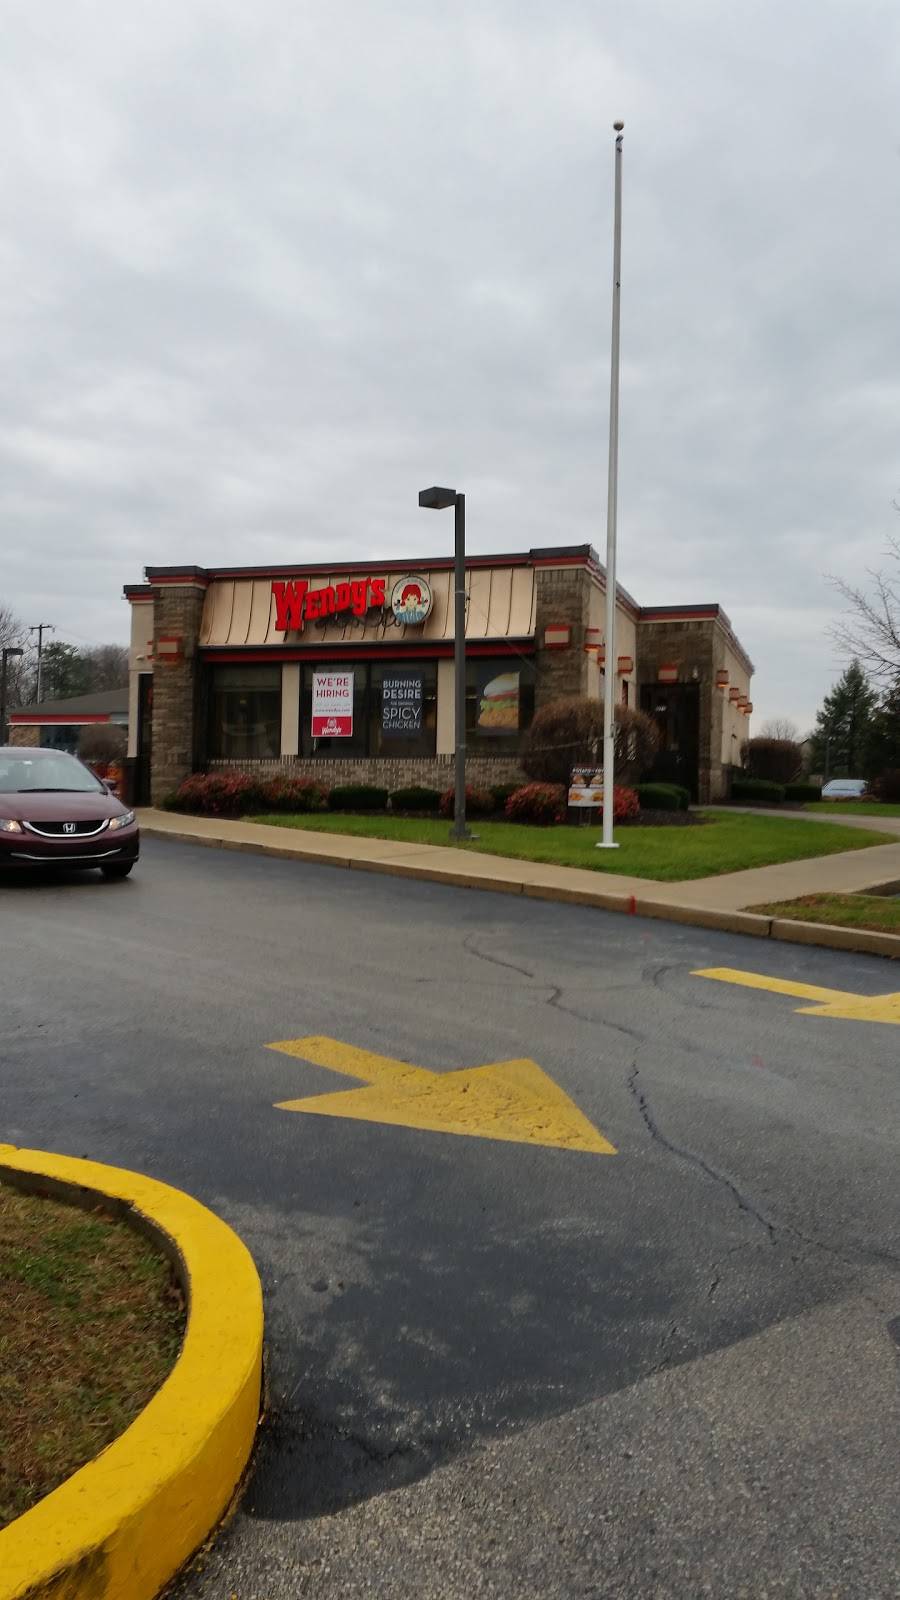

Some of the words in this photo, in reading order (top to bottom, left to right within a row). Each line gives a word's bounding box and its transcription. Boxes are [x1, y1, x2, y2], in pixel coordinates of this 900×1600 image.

[317, 677, 349, 687] WE'RE
[382, 679, 422, 689] BURNING
[316, 689, 350, 698] HIRING
[383, 689, 422, 699] DESIRE
[382, 705, 422, 720] SPICY
[382, 720, 421, 729] CHICKEN
